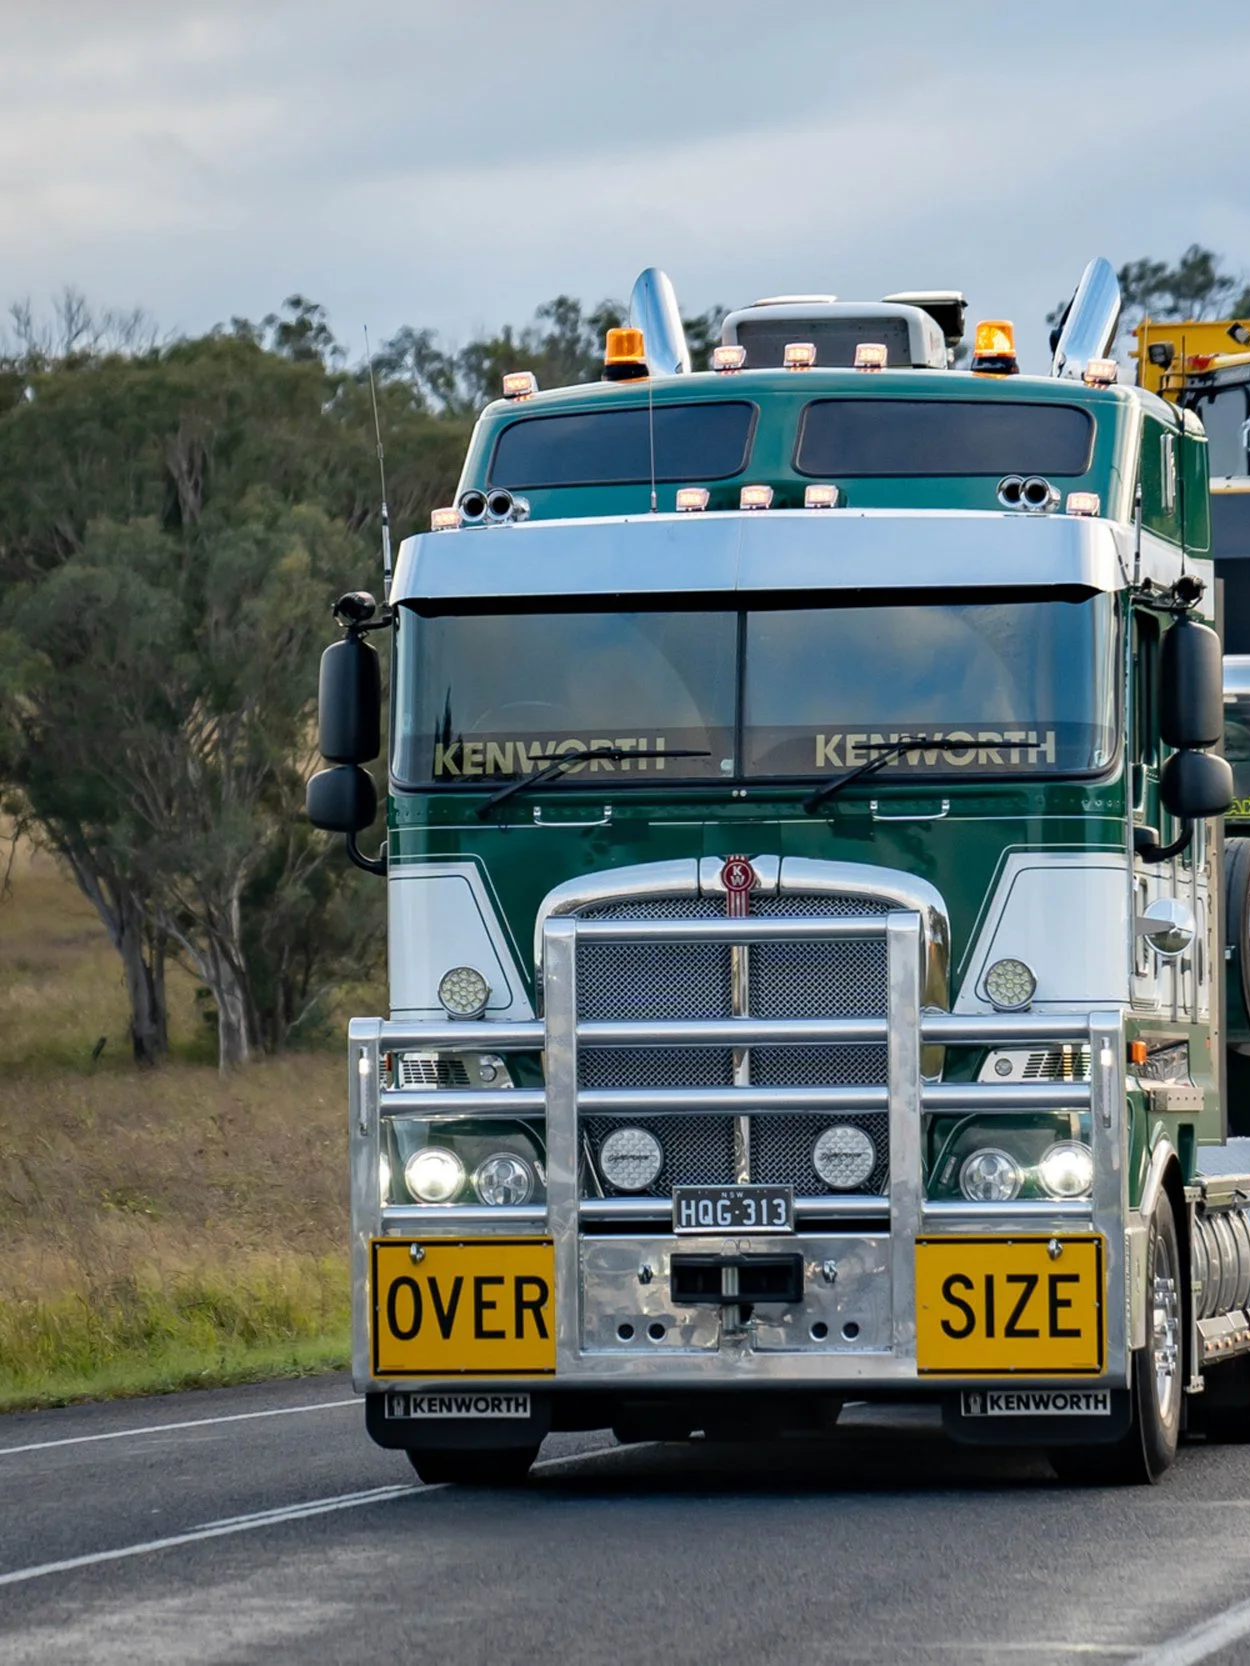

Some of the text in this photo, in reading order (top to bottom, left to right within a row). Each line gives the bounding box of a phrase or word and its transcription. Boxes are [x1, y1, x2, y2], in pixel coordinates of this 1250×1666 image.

[434, 737, 665, 775] KENWORTH
[815, 731, 1056, 768] KENWORTH
[387, 1275, 549, 1341] OVER
[940, 1273, 1082, 1339] SIZE
[413, 1396, 528, 1414] KENWORTH
[990, 1393, 1107, 1411] KENWORTH
